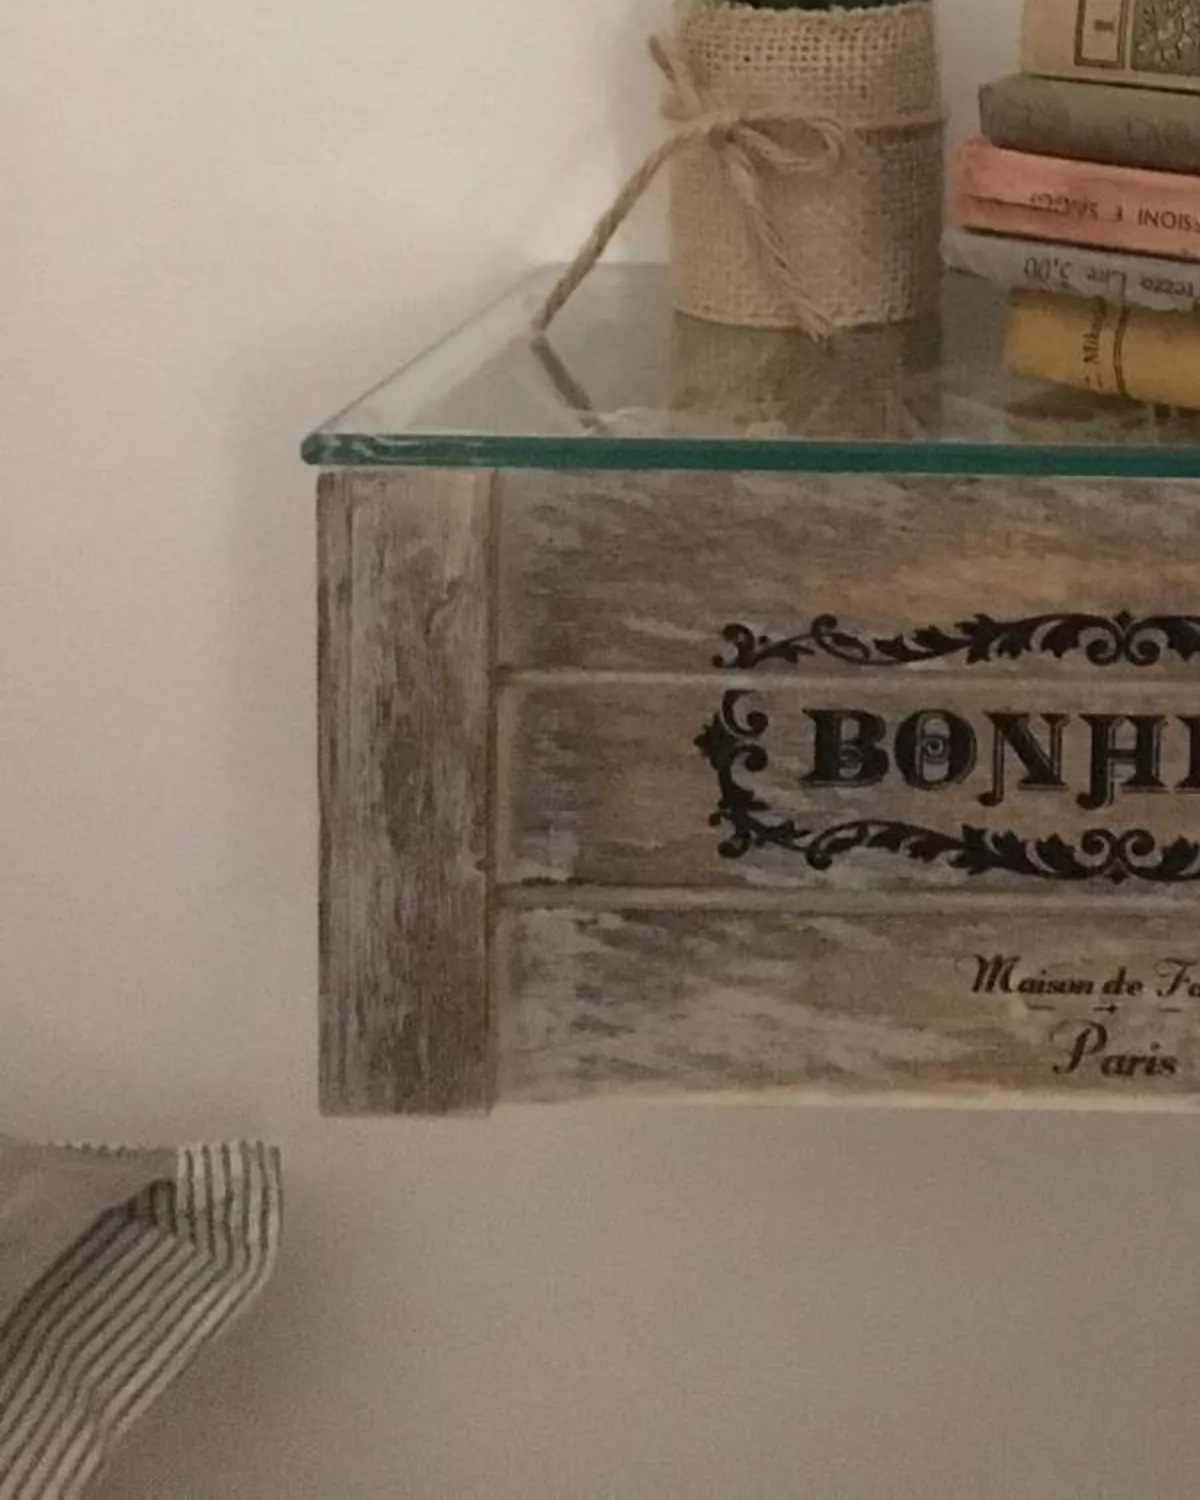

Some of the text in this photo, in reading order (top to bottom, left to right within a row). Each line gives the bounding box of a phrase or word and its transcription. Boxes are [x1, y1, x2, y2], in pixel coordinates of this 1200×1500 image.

[968, 953, 1095, 999] Maison
[1101, 964, 1143, 999] de
[1051, 1018, 1178, 1079] Paris
